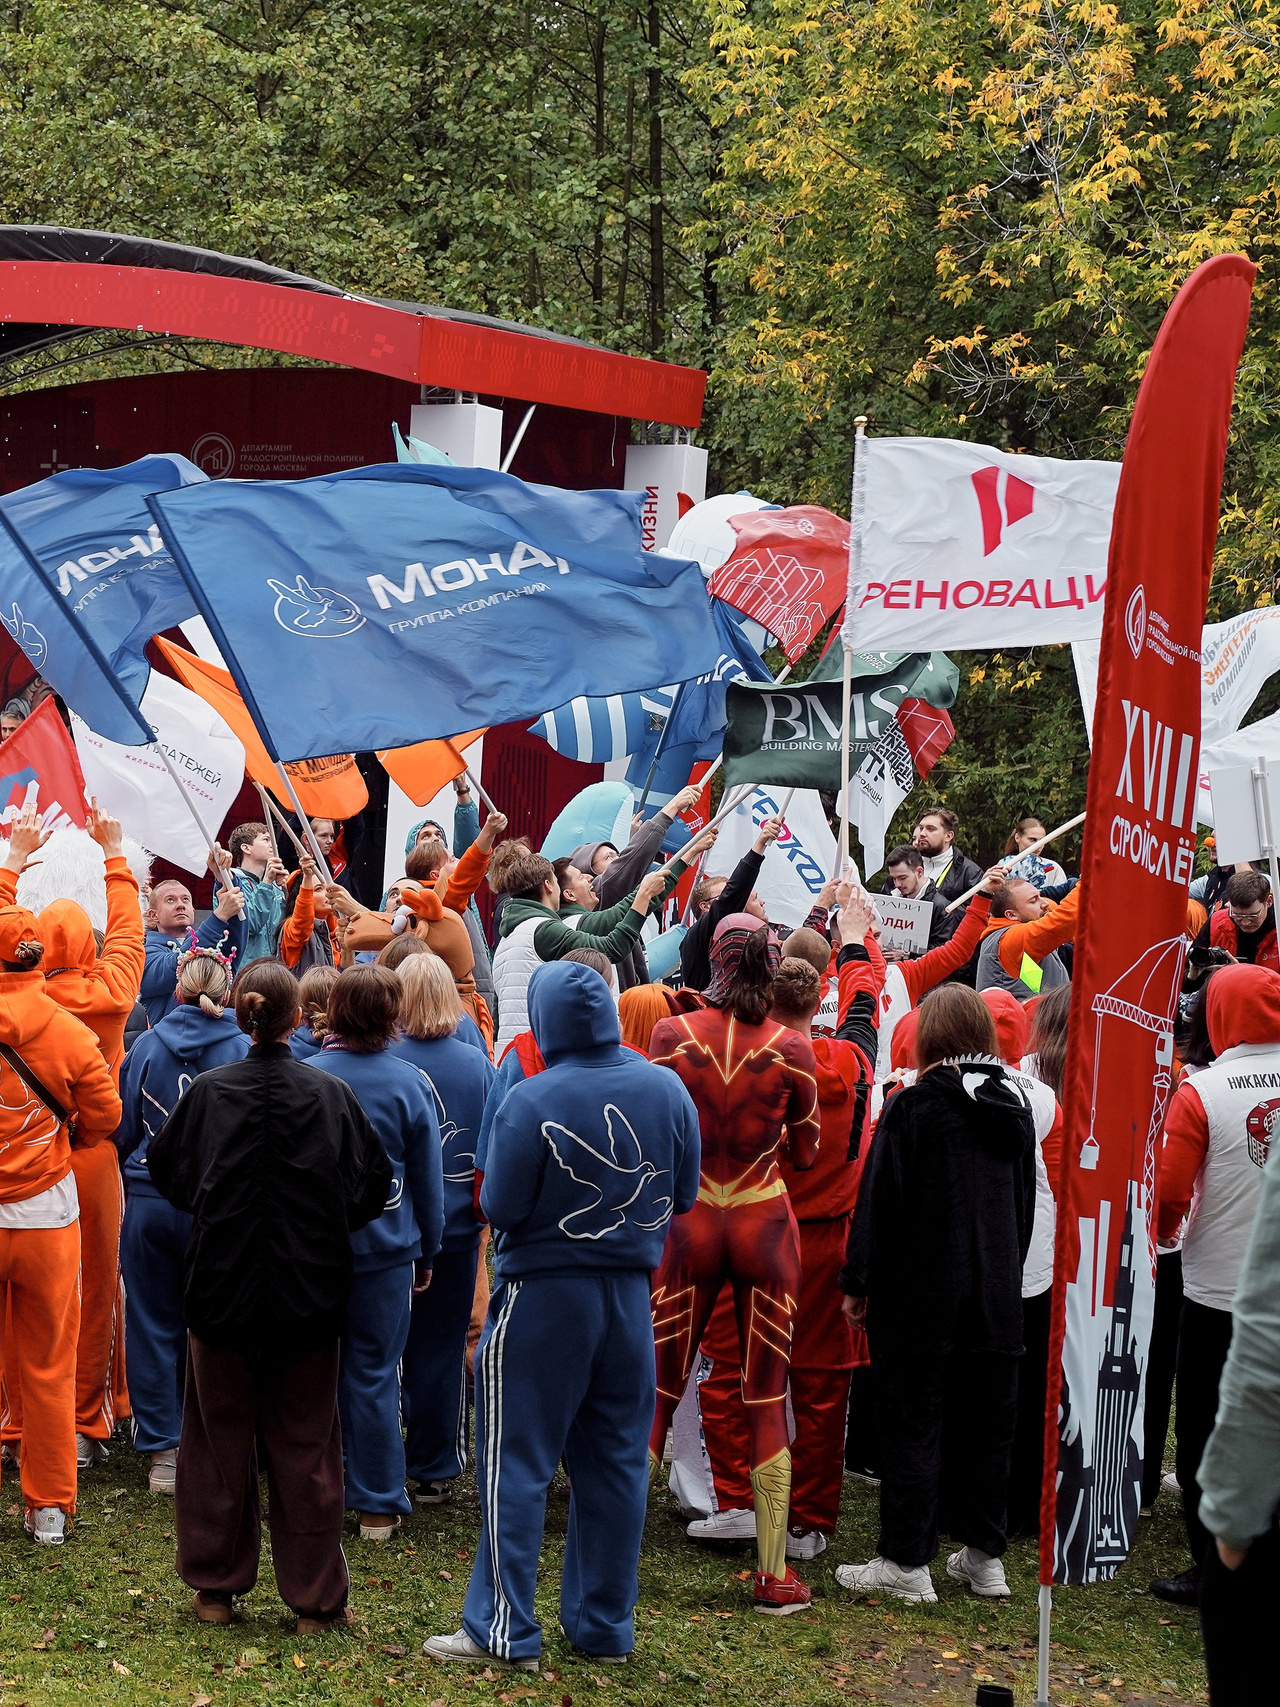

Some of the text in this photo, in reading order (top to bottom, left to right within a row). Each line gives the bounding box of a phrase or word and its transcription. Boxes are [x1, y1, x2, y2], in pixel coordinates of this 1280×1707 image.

[240, 444, 293, 452] ДЕПАРТАМЕНТ
[239, 453, 365, 463] ГРАДОСТРОИТЕЛЬНОЙ ПОЛИТИКИ
[239, 464, 307, 472] ГОРОДА МОСКВЫ
[388, 582, 552, 634] ГРУППА КОМПАНИЙ
[1210, 629, 1258, 706] КОМПАНИЯ
[760, 684, 909, 742] BMS
[760, 741, 823, 751] BUILDING
